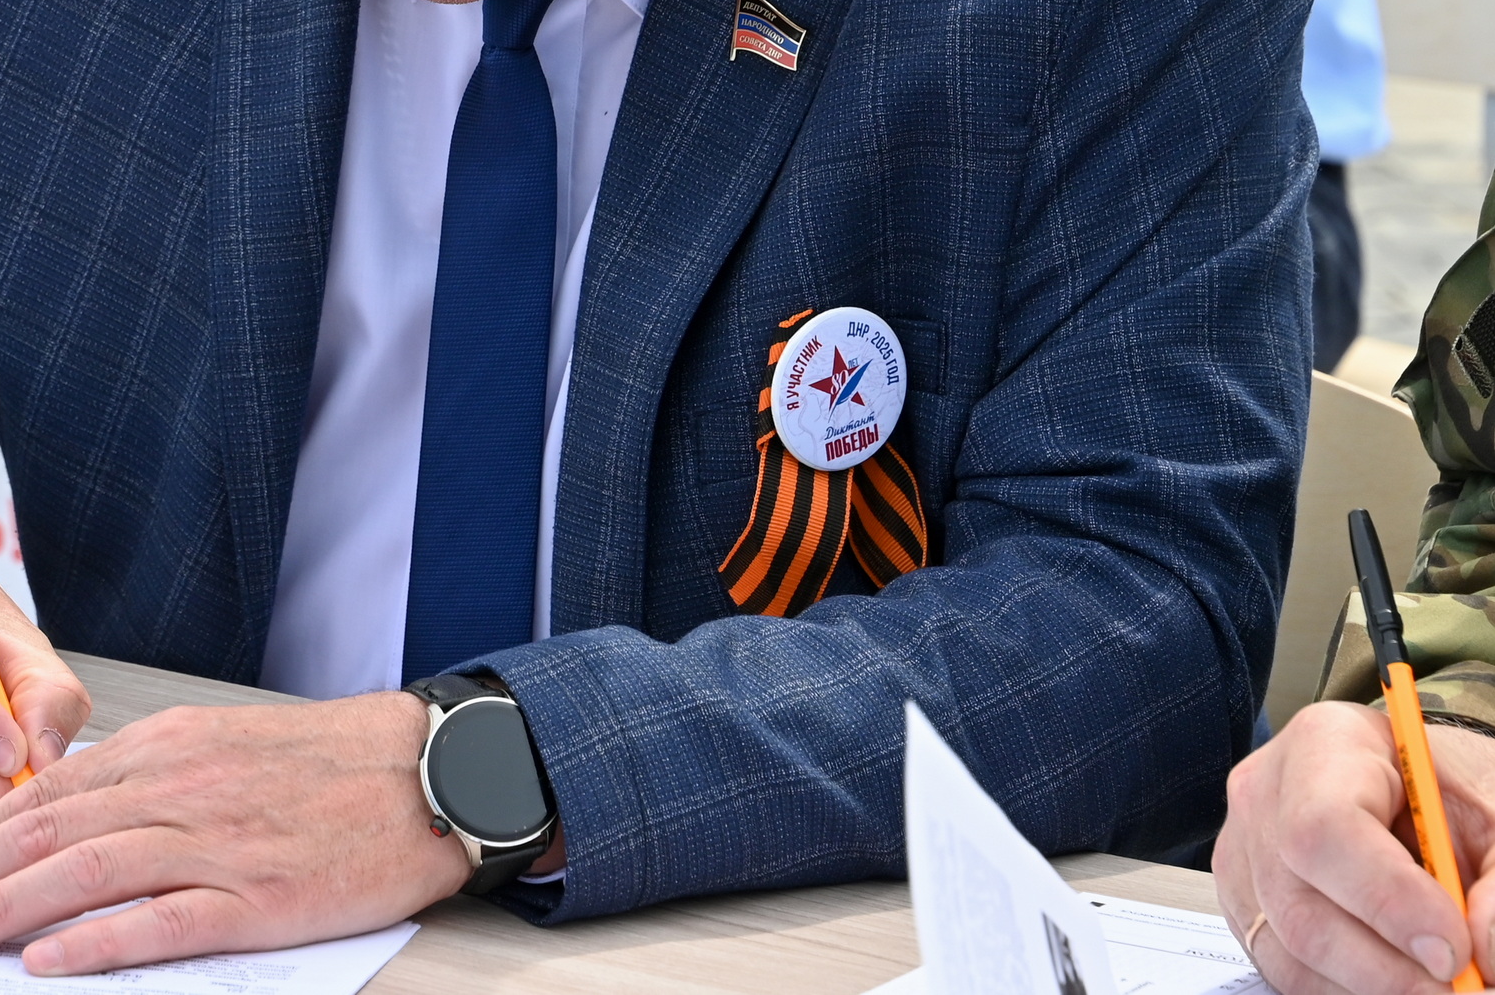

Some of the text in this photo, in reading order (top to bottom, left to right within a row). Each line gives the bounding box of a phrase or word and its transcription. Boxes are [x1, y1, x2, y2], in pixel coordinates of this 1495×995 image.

[743, 1, 777, 22] ДЕПУТАТ
[741, 18, 784, 45] НАРОДНОГО
[739, 35, 783, 60] СОВЕТА ДНР
[847, 321, 900, 385] ДНР, 2025 ГОД
[787, 335, 823, 410] Я УЧАСТНИК
[830, 369, 849, 395] 80
[824, 411, 875, 440] Диктант
[825, 423, 879, 462] ПОБЕДЫ
